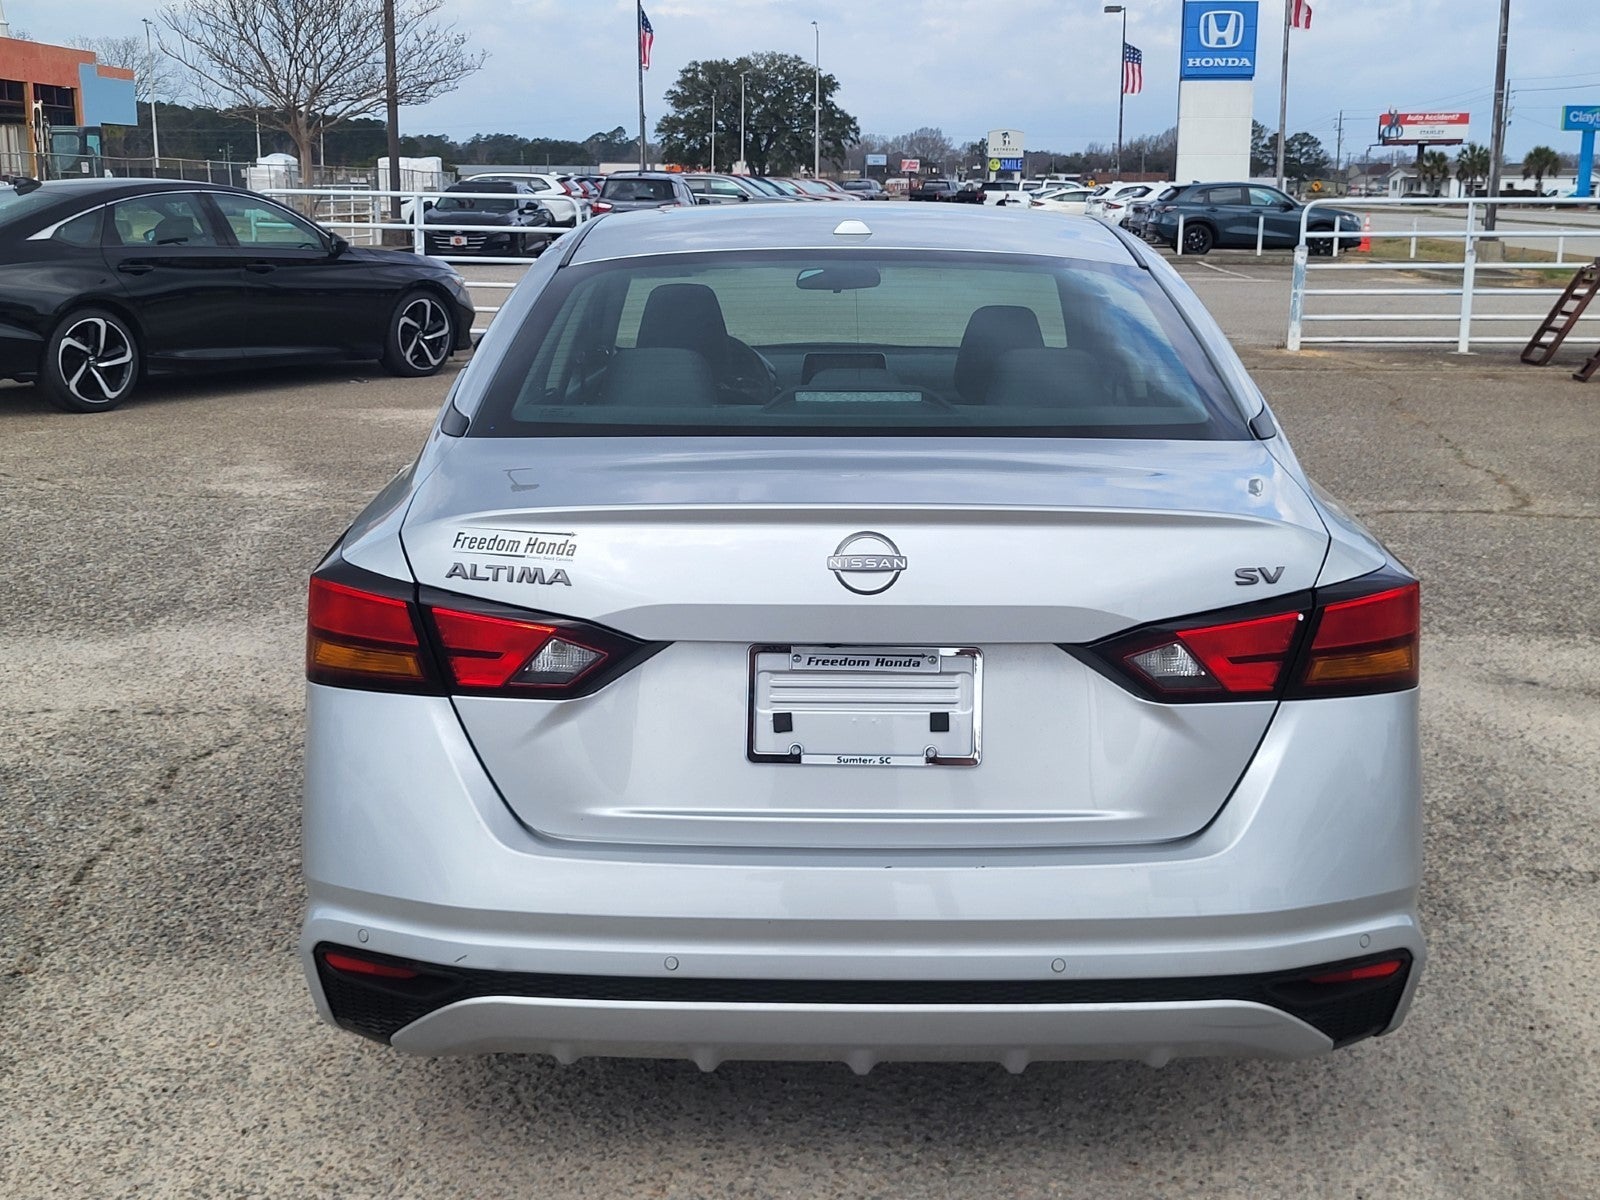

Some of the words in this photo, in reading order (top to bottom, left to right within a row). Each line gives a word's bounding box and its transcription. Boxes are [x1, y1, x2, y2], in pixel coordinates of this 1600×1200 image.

[1187, 57, 1252, 67] HONDA
[1424, 113, 1460, 121] Accident?
[1000, 159, 1022, 170] SMILE
[452, 532, 521, 553] Freedom
[523, 536, 577, 557] Honda
[829, 558, 906, 568] NISSAN
[445, 562, 572, 587] ALTIMA
[1234, 566, 1285, 586] SV
[806, 656, 870, 667] Freedom
[875, 657, 921, 668] Honda
[878, 756, 892, 765] SC
